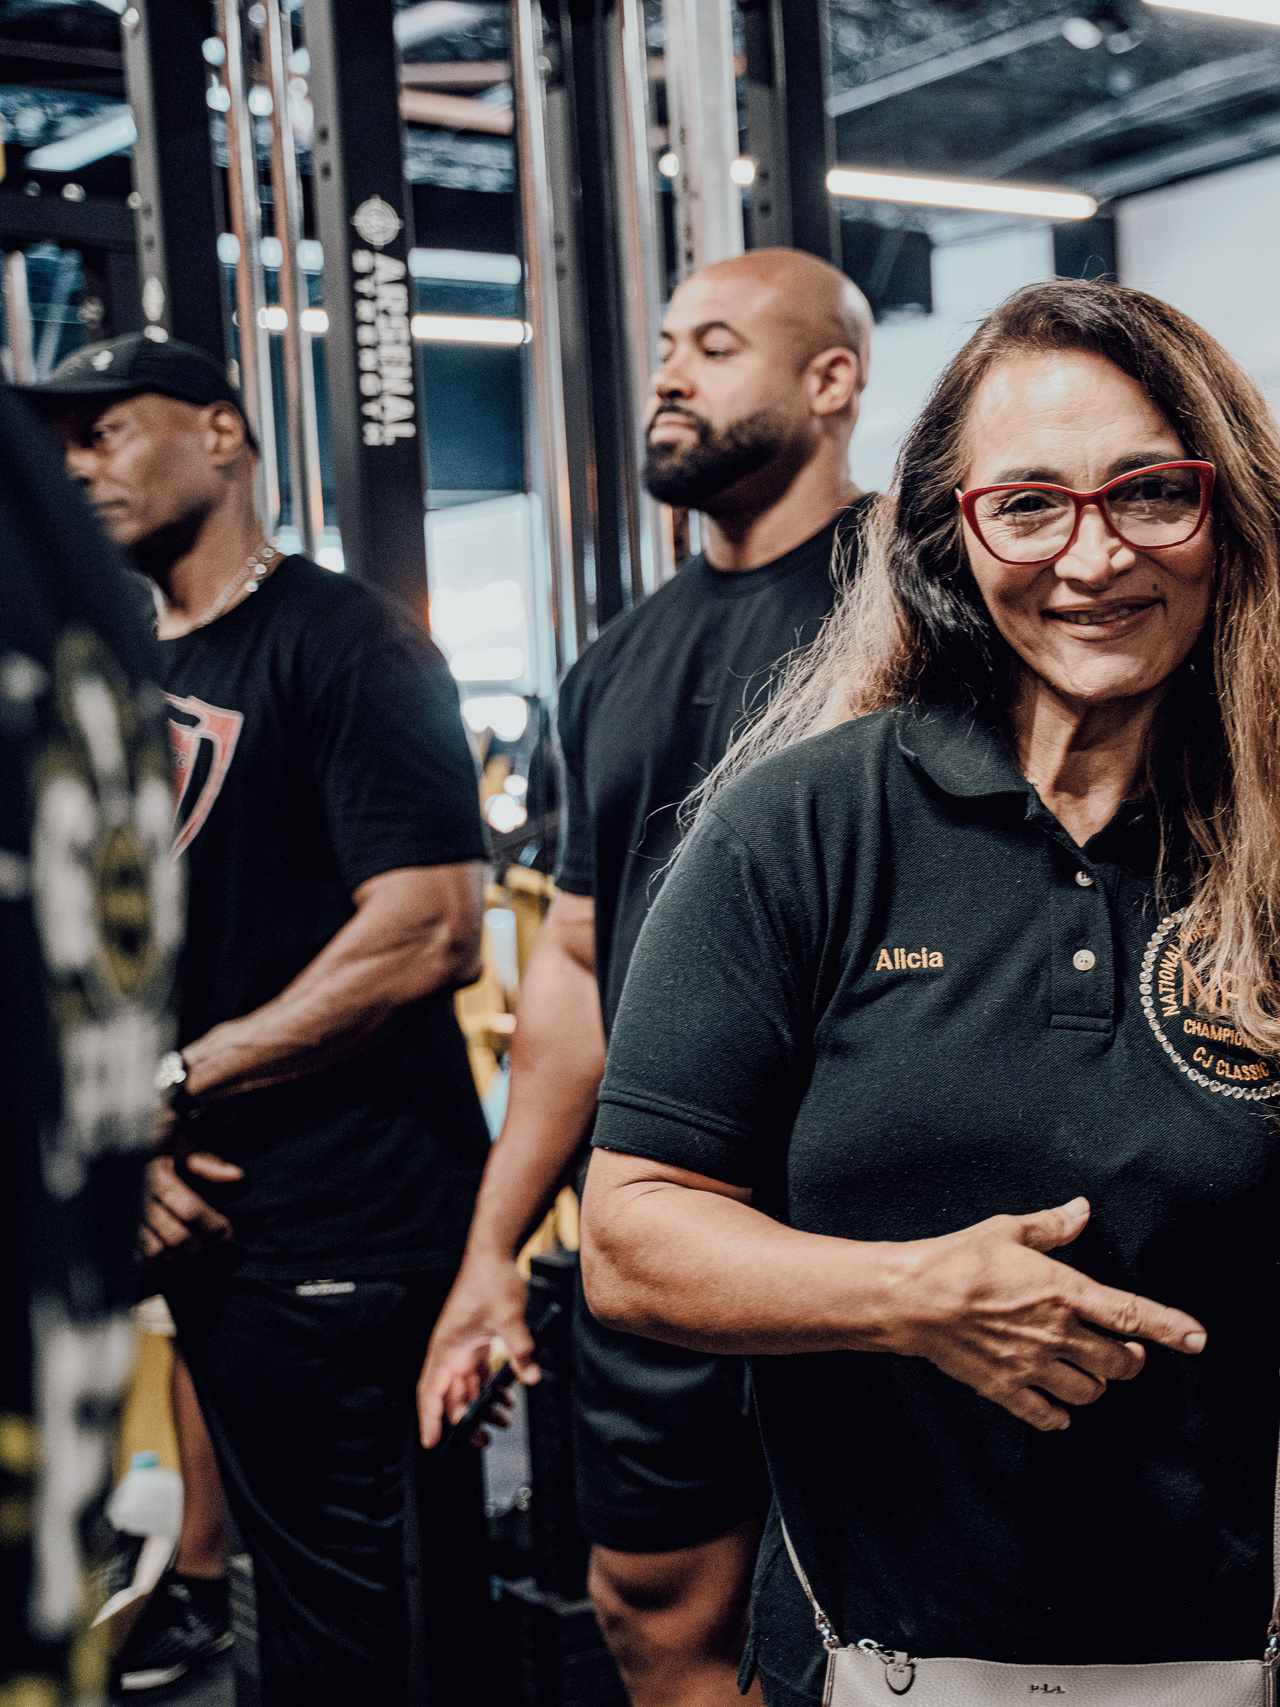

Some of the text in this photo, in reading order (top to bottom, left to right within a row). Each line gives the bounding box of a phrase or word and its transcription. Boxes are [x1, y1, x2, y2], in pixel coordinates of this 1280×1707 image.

[374, 251, 417, 446] ARSENAL
[875, 946, 944, 971] Alicia
[1157, 943, 1184, 1018] NATIONAL
[1192, 1046, 1270, 1082] CJ CLASSIC
